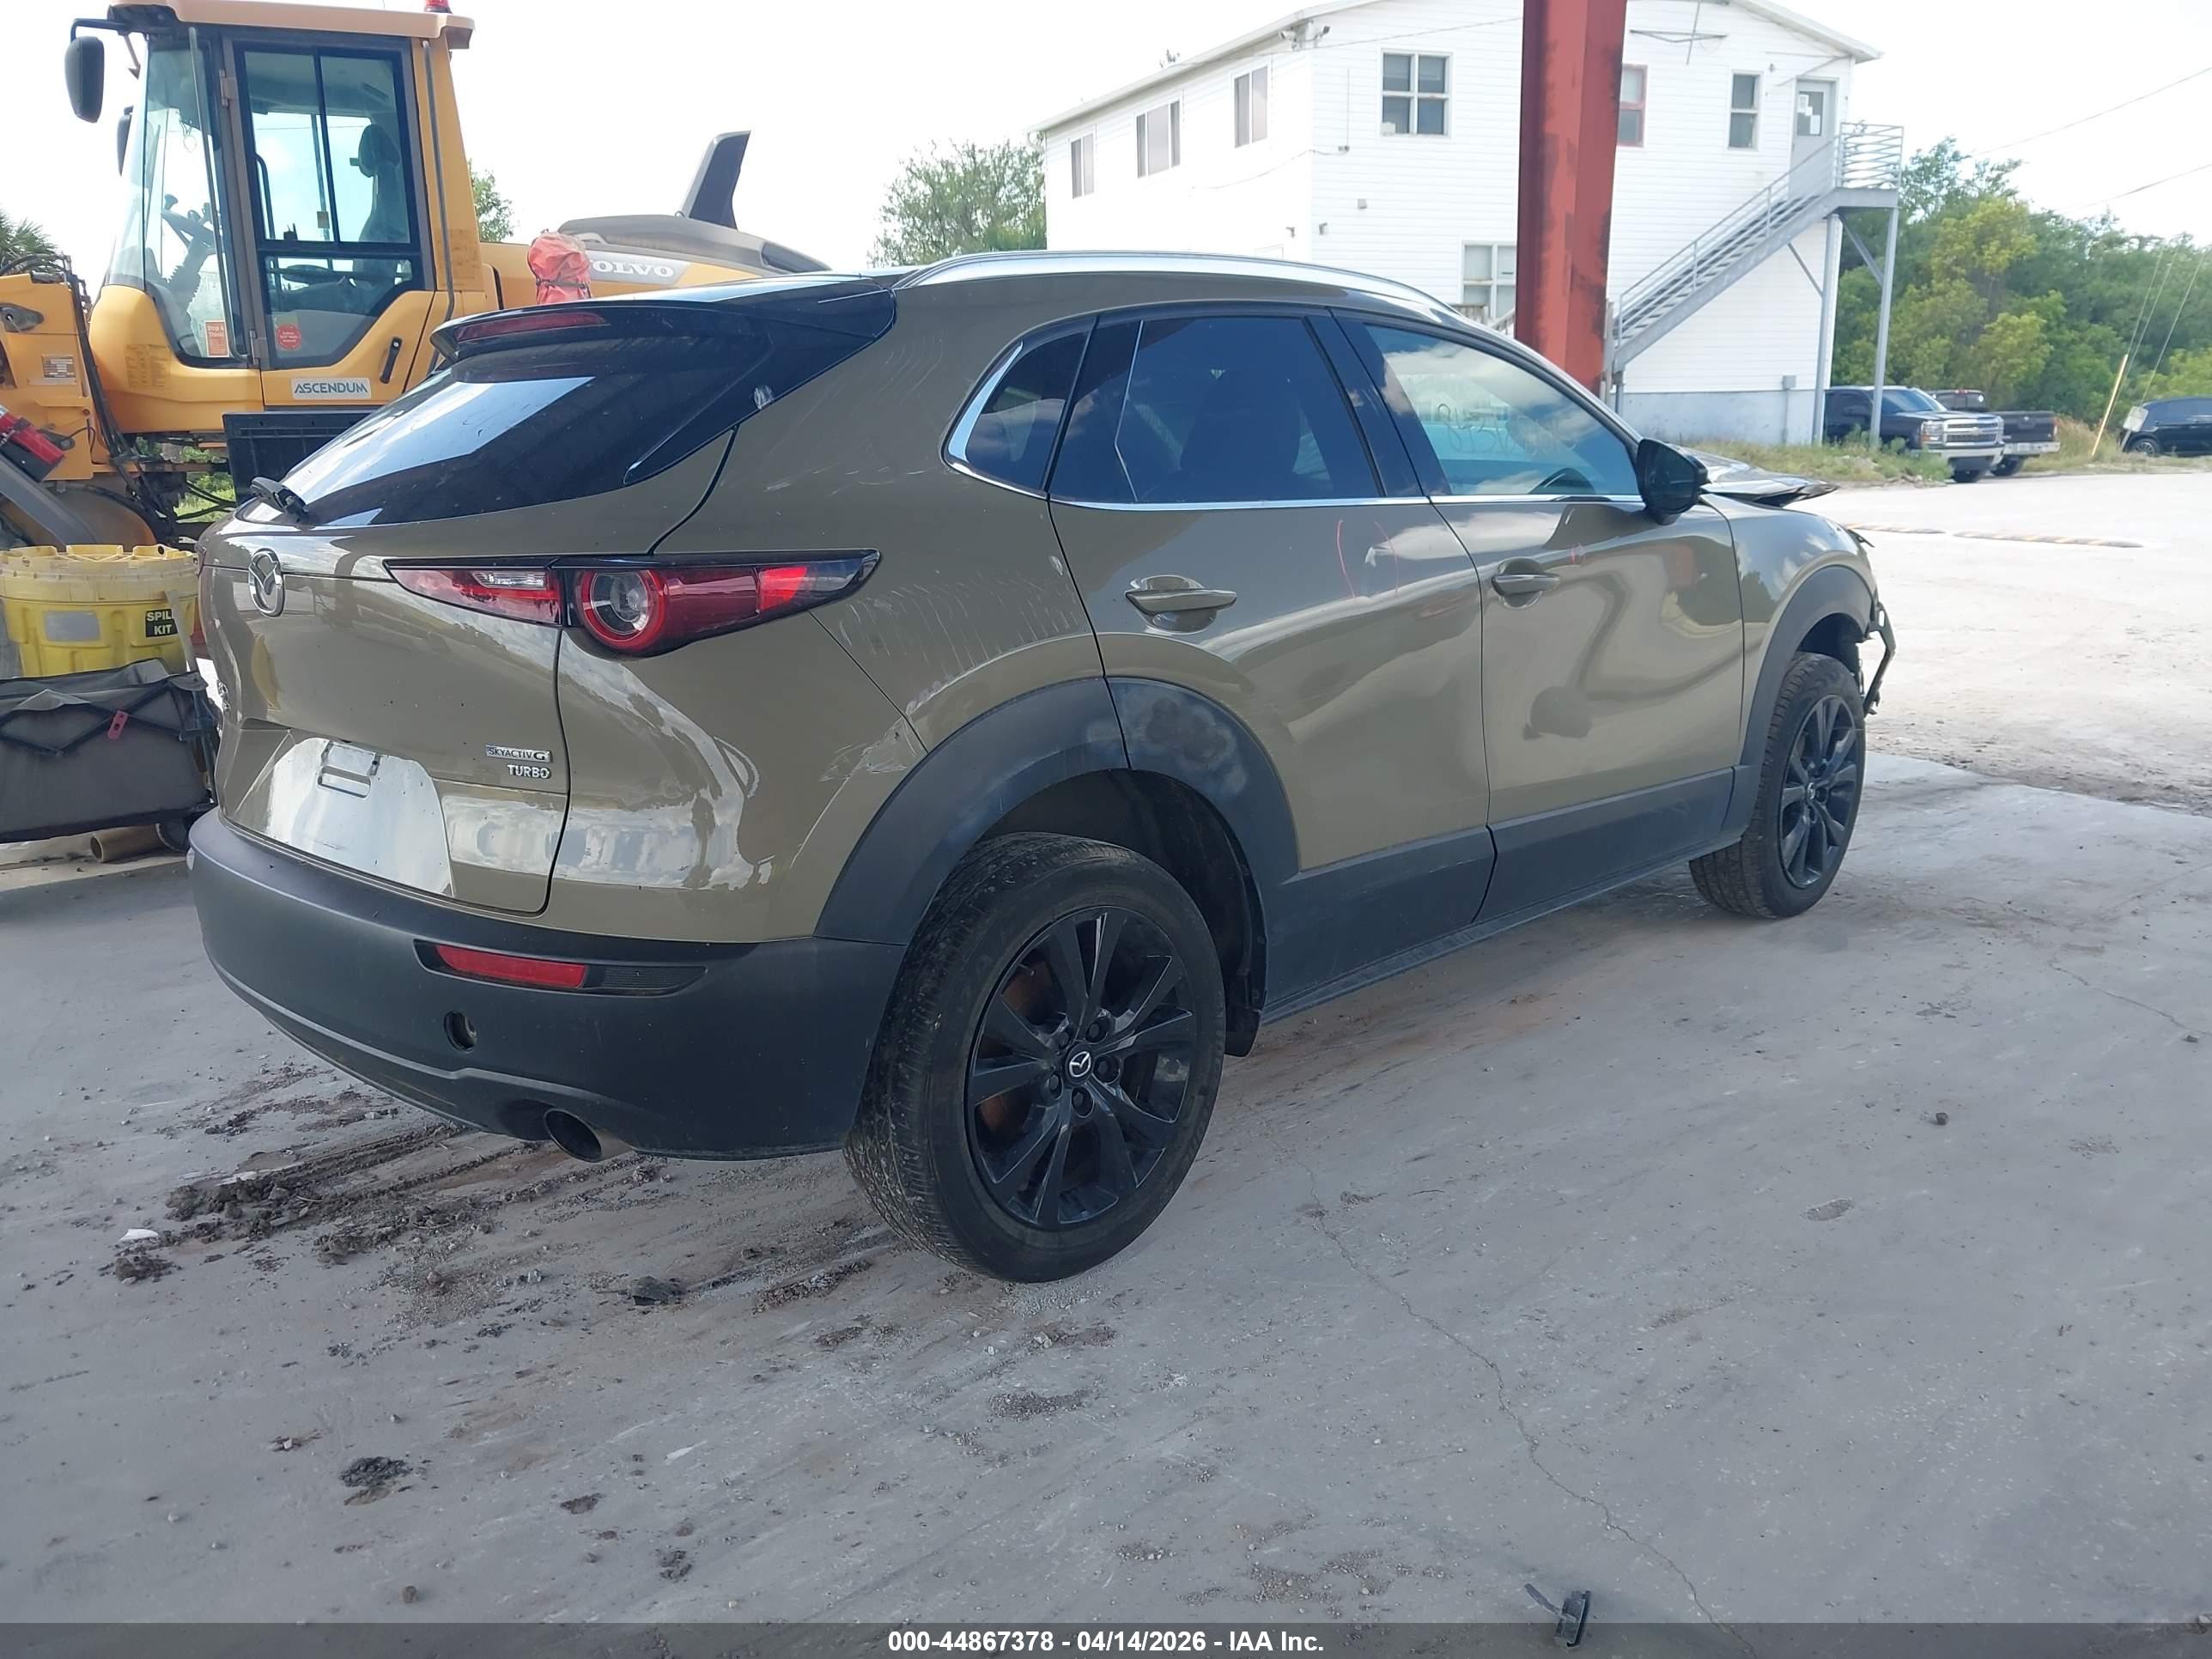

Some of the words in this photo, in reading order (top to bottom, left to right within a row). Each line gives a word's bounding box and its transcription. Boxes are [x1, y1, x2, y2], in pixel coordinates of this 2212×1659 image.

[589, 259, 674, 277] OLVO
[295, 382, 368, 394] ASCENDUM
[146, 611, 173, 622] SPIL
[154, 623, 173, 635] KIT
[507, 764, 550, 779] TURBO
